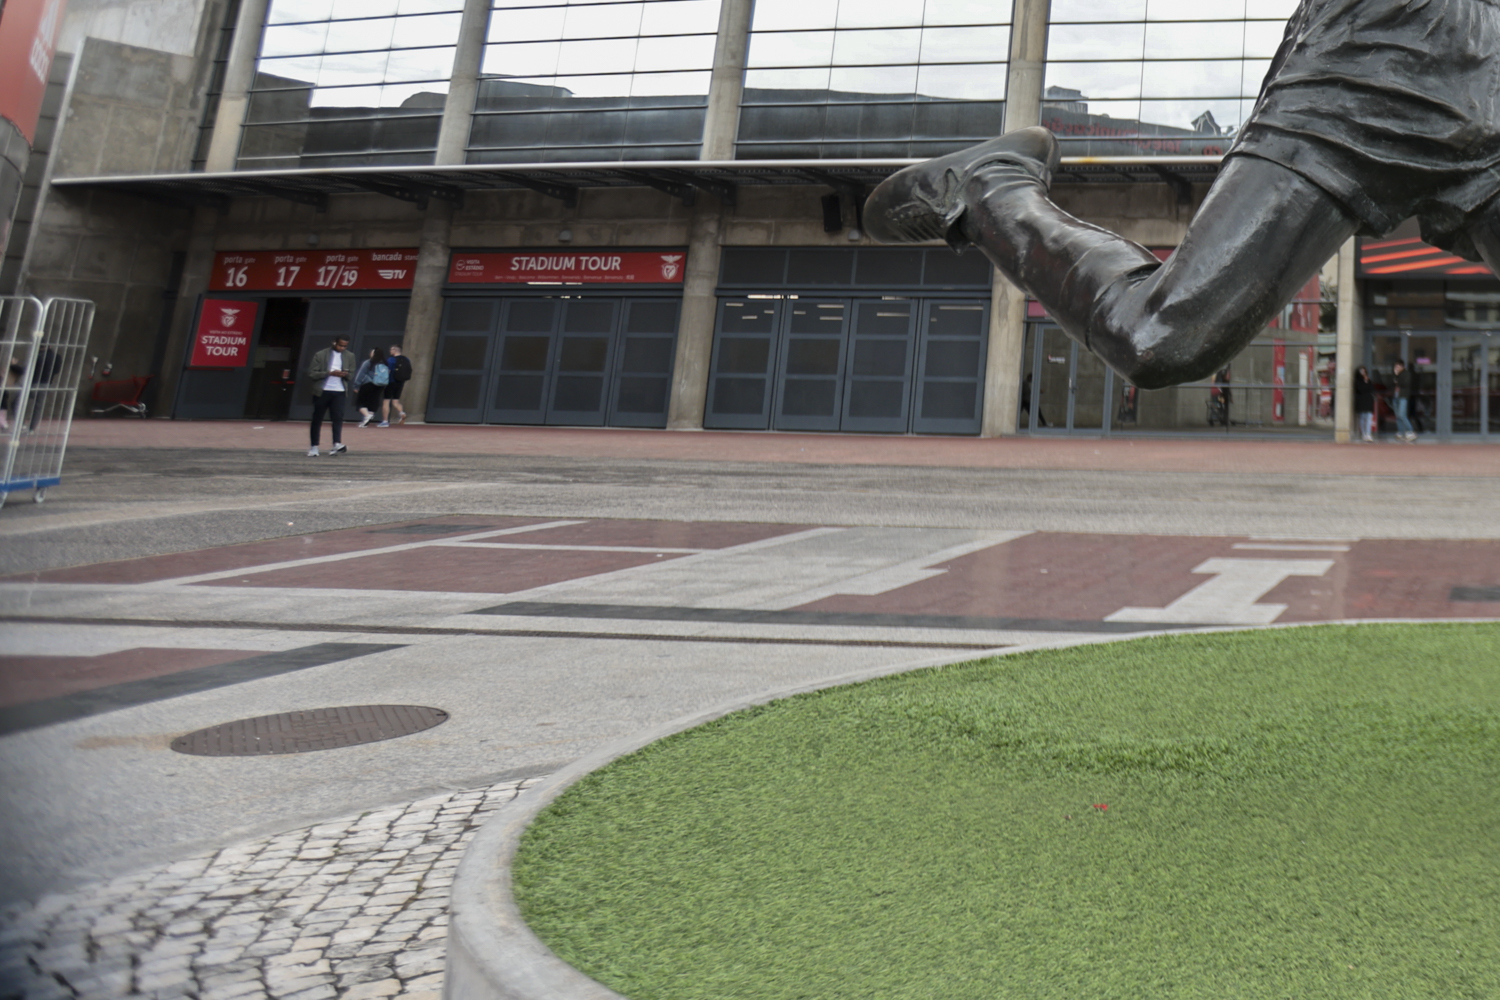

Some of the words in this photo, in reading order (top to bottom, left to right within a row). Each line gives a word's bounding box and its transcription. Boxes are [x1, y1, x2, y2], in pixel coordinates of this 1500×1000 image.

[224, 256, 243, 265] porta
[275, 255, 294, 264] porta
[325, 254, 345, 264] porta
[372, 252, 402, 261] bancada
[510, 256, 576, 271] STADIUM
[579, 256, 622, 271] TOUR
[225, 266, 248, 287] 16
[276, 266, 300, 287] 17
[377, 269, 407, 280] BTV
[201, 335, 246, 345] STADIUM
[206, 346, 239, 356] TOUR
